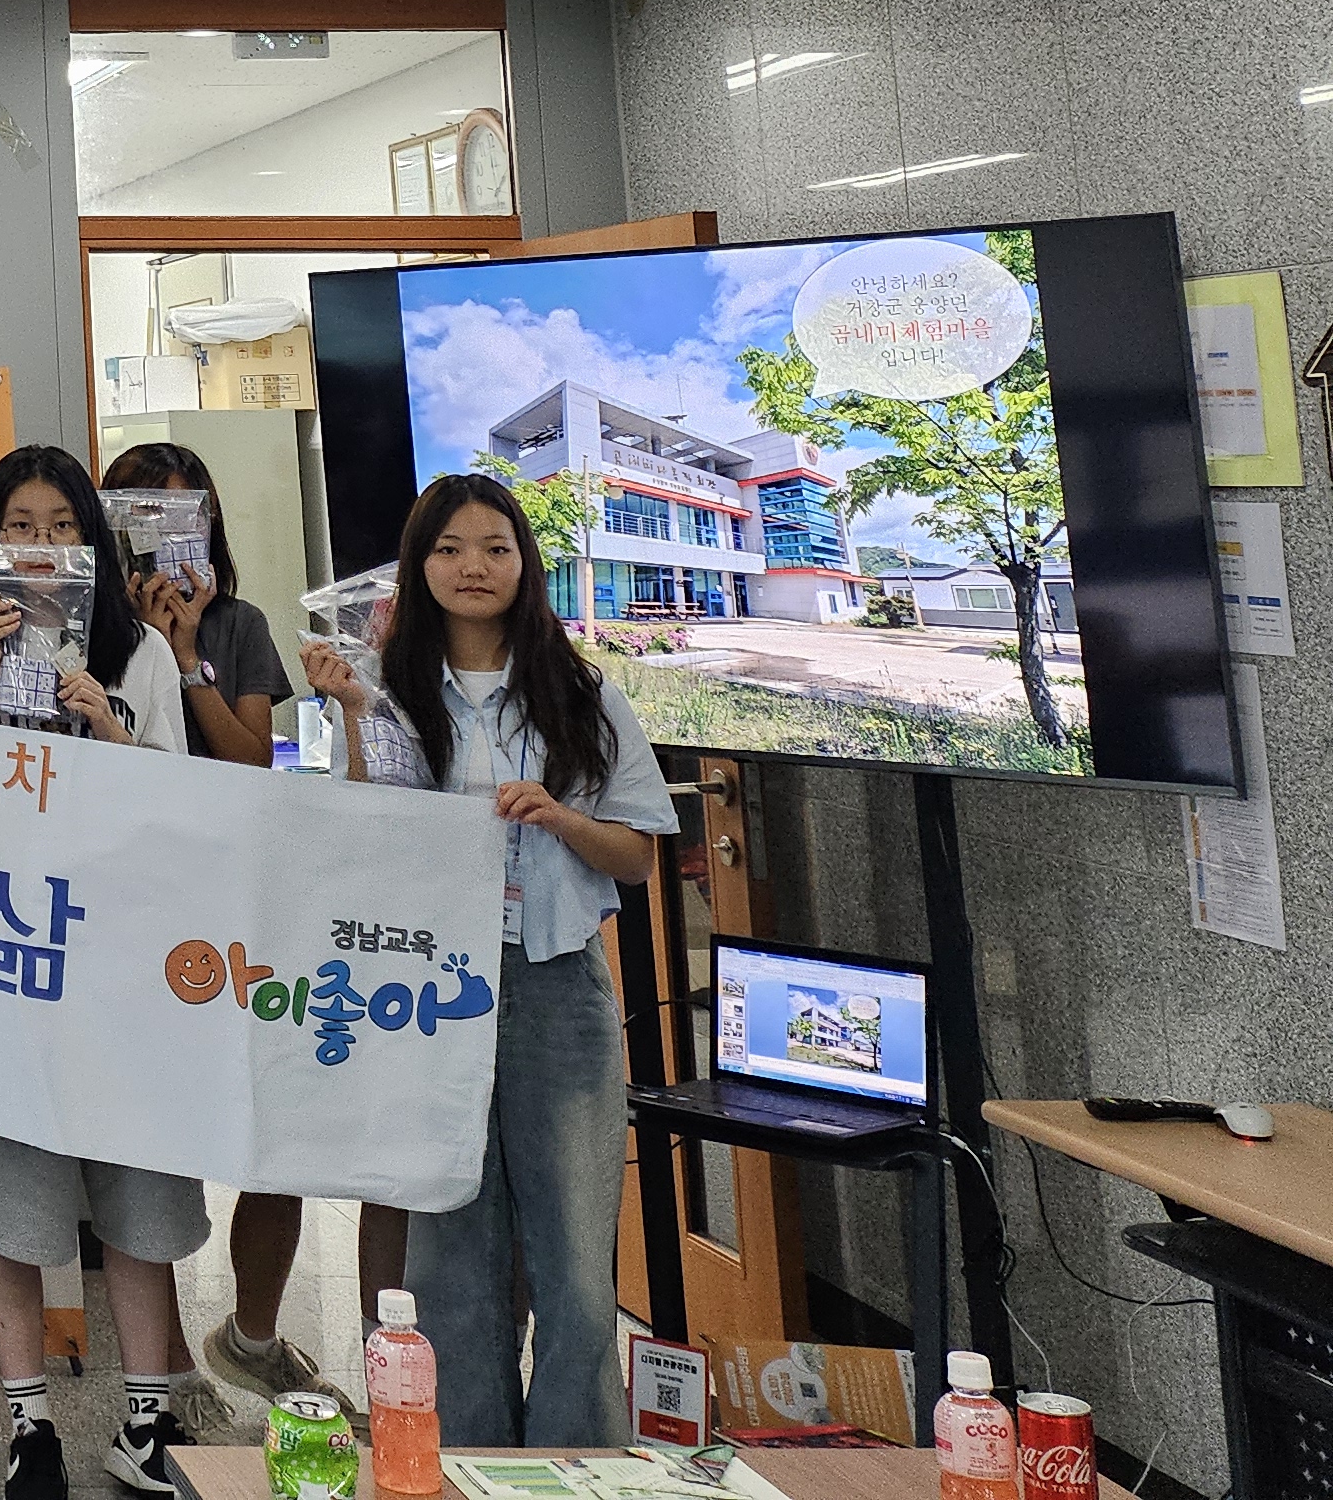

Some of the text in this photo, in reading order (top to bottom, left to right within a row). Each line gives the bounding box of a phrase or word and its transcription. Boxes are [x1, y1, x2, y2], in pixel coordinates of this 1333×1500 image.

[881, 349, 945, 366] 입니다!
[331, 919, 437, 961] 경남교육
[965, 1424, 1008, 1439] COCO
[1022, 1445, 1091, 1484] a-Cola
